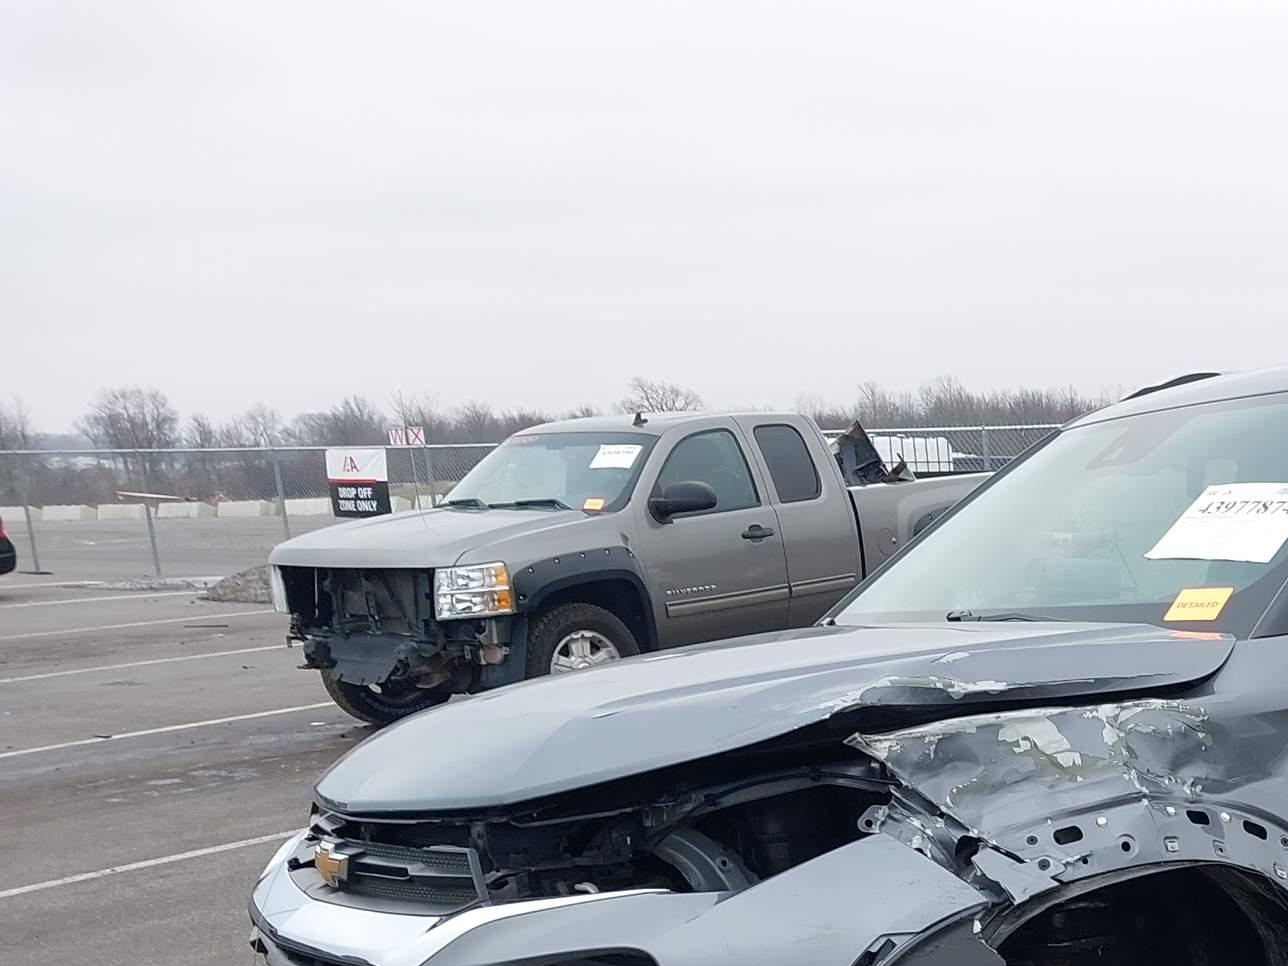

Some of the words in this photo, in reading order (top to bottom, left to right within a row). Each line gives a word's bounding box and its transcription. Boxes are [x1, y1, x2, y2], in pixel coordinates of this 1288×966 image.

[337, 486, 357, 499] DROP
[357, 487, 373, 500] OFF
[338, 499, 357, 512] ZONE
[356, 500, 378, 513] ONLY
[1176, 600, 1220, 609] DETAILED
